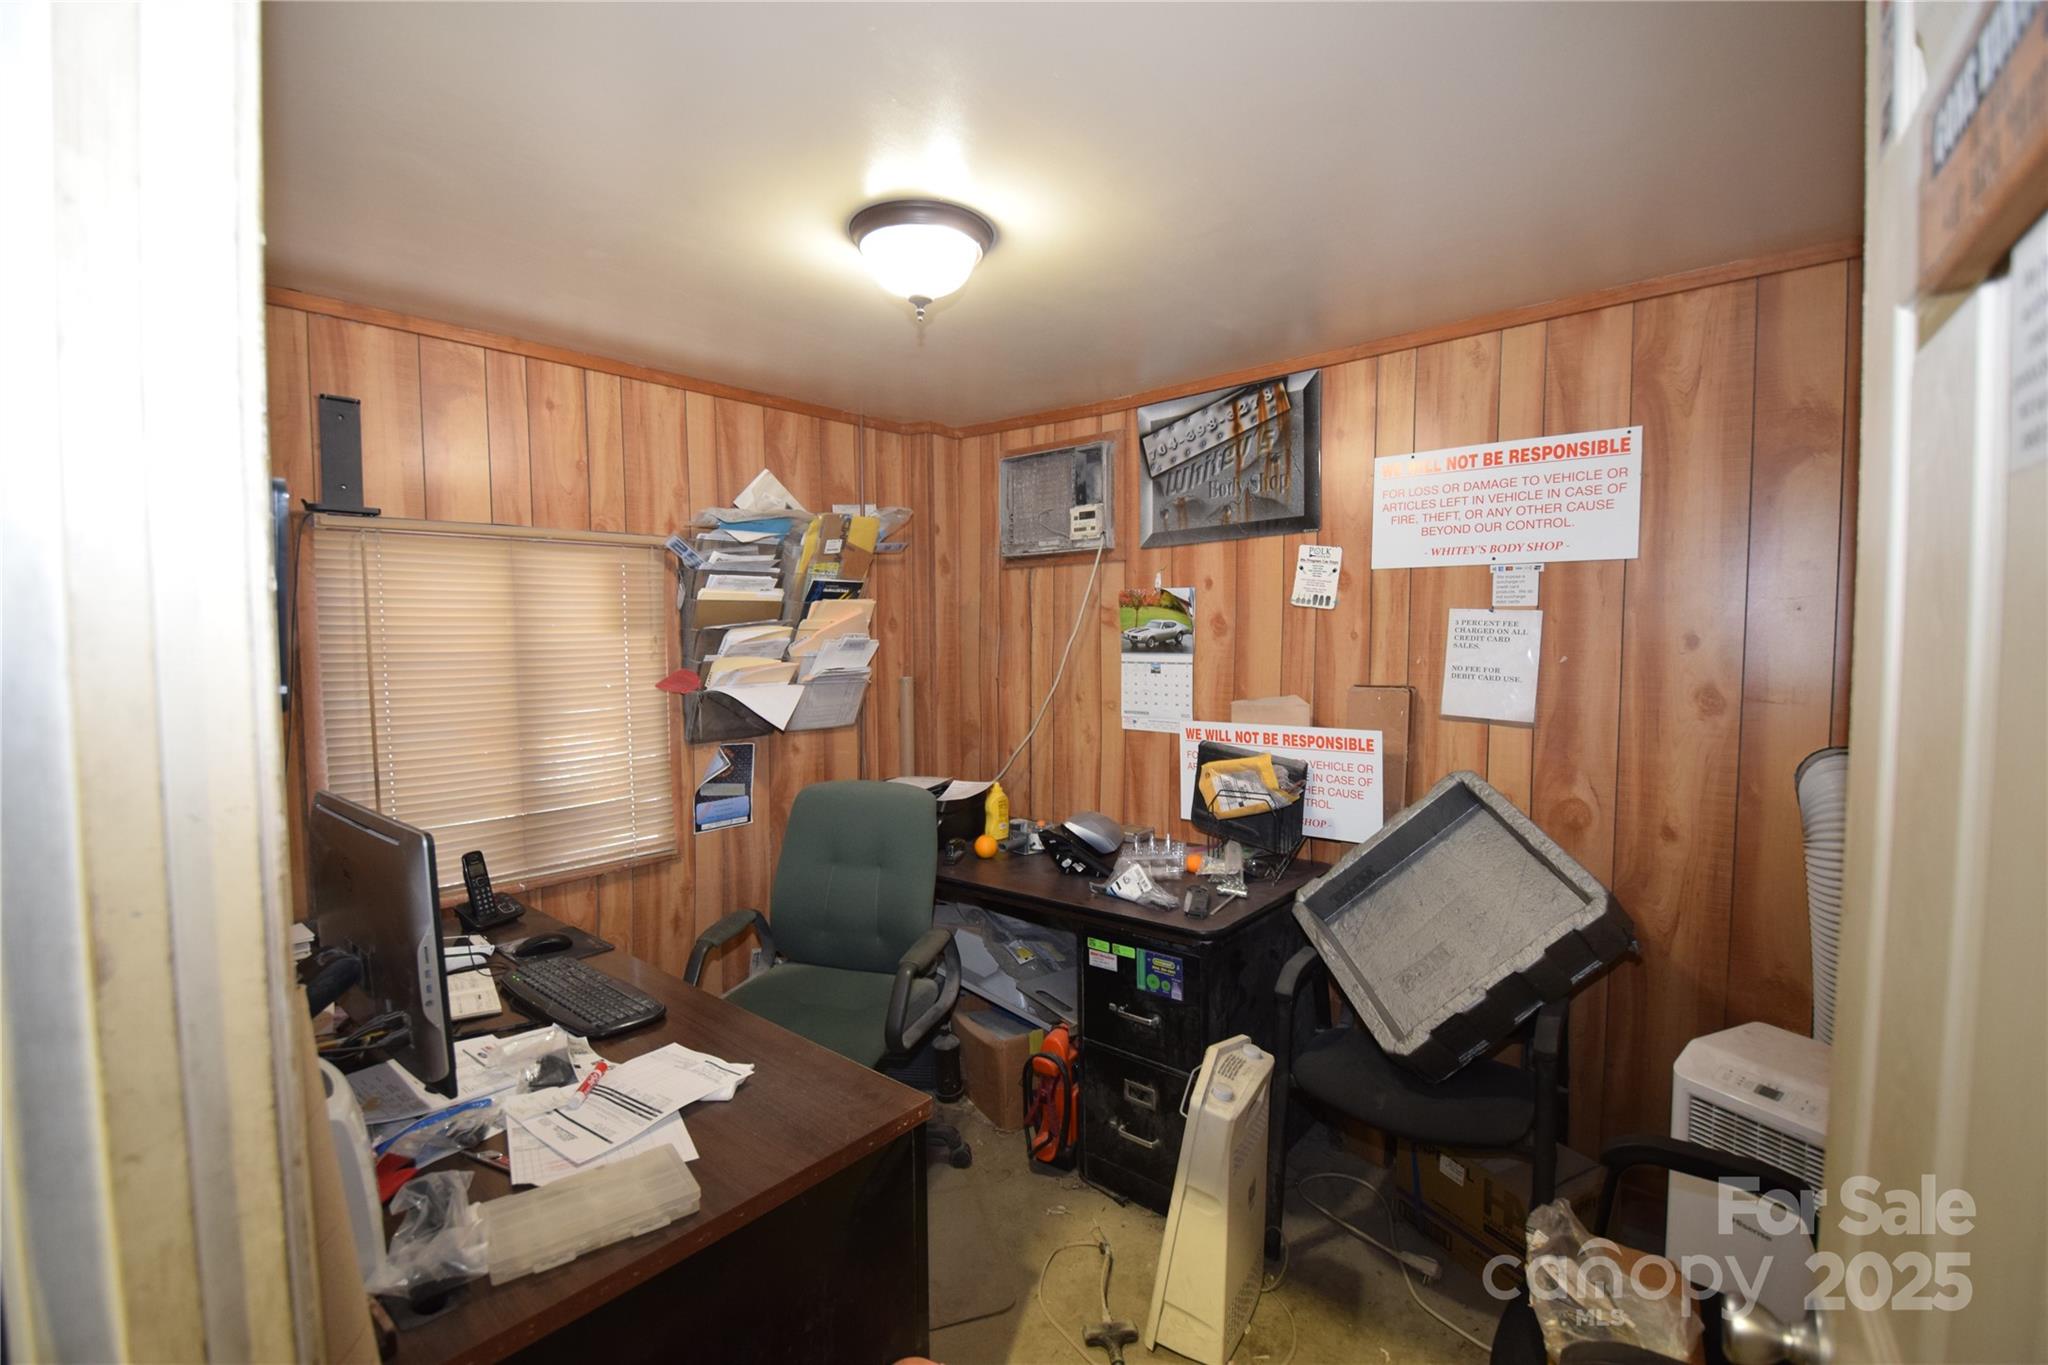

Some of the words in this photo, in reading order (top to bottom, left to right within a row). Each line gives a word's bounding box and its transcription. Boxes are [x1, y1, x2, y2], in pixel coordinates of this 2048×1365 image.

[1446, 453, 1478, 470] NOT
[1483, 451, 1503, 466] BE
[1509, 437, 1631, 464] RESPONSIBLE
[1382, 489, 1405, 499] FOR
[1408, 485, 1439, 497] LOSS
[1442, 483, 1460, 494] OR
[1463, 477, 1518, 492] DAMAGE
[1522, 475, 1540, 486] TO
[1544, 469, 1603, 484] VEHICLE
[1607, 467, 1628, 479] OR
[1382, 499, 1436, 512] ARTICLES
[1440, 496, 1469, 508] LEFT
[1472, 495, 1485, 505] IN
[1488, 490, 1543, 503] VEHICLE
[1547, 488, 1560, 498] IN
[1565, 485, 1603, 498] CASE
[1607, 482, 1628, 494] OF
[1464, 509, 1483, 520] OR
[1486, 507, 1512, 518] ANY
[1516, 503, 1562, 516] OTHER
[1566, 499, 1615, 512] CAUSE
[1421, 524, 1470, 536] BEYOND
[1474, 522, 1502, 533] OUR
[1506, 518, 1575, 531] CONTROL.
[1431, 545, 1487, 556] WHITEY'S
[1489, 543, 1524, 554] BODY
[1527, 541, 1564, 552] SHOP
[1185, 727, 1202, 740] WE
[1205, 728, 1231, 742] WILL
[1235, 731, 1260, 744] NOT
[1263, 733, 1278, 746] BE
[1282, 733, 1374, 752] RESPONSIBLE
[1187, 750, 1199, 759] FO
[1309, 760, 1354, 772] VEHICLE
[1357, 763, 1374, 774] OR
[1312, 773, 1323, 783] IN
[1326, 774, 1355, 785] CASE
[1358, 777, 1373, 787] OF
[1305, 786, 1325, 795] HER
[1327, 787, 1365, 800] CAUSE
[1304, 798, 1335, 809] TROL.
[1302, 817, 1327, 828] HOP
